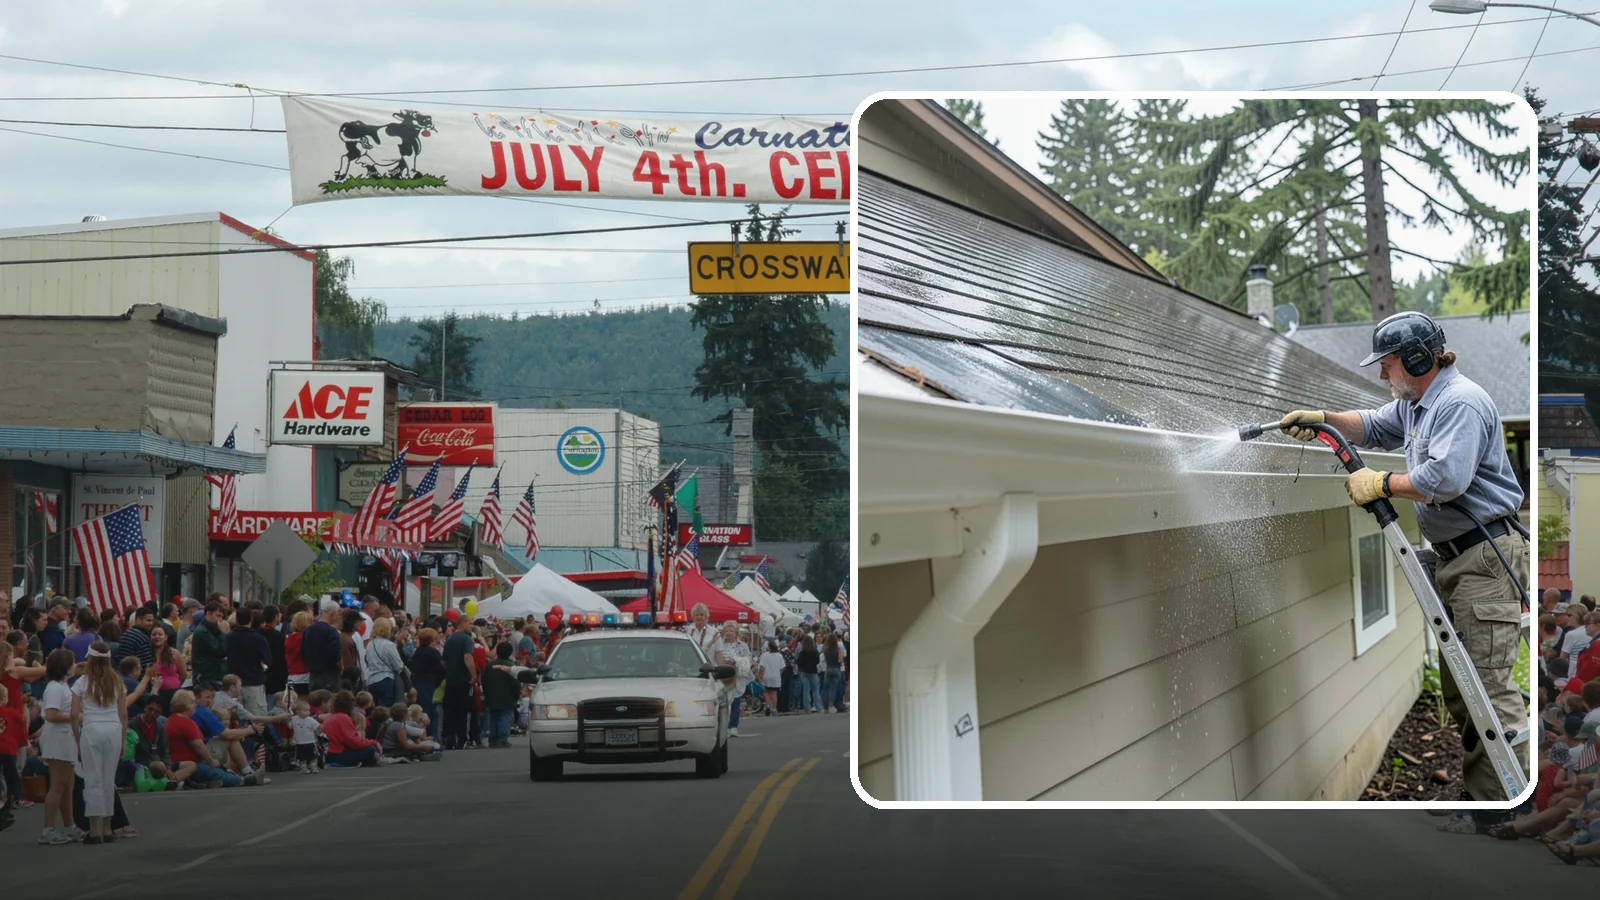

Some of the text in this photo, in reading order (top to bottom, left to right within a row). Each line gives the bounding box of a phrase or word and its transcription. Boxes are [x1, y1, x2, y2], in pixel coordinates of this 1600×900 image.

[695, 121, 850, 150] Carnat
[481, 140, 605, 192] JULY
[632, 150, 746, 198] 4th.
[696, 254, 850, 280] CROSSWA
[283, 380, 373, 420] ACE
[405, 409, 485, 422] CEDAR LOG
[283, 421, 371, 436] Hardware
[416, 428, 477, 447] Coca-Cola
[353, 467, 386, 480] Simpl
[83, 485, 155, 495] St. Vincent de Paul
[81, 503, 153, 522] THRT
[212, 515, 331, 536] HARDARE
[688, 526, 741, 535] CRNATION
[699, 535, 730, 544] GLASS
